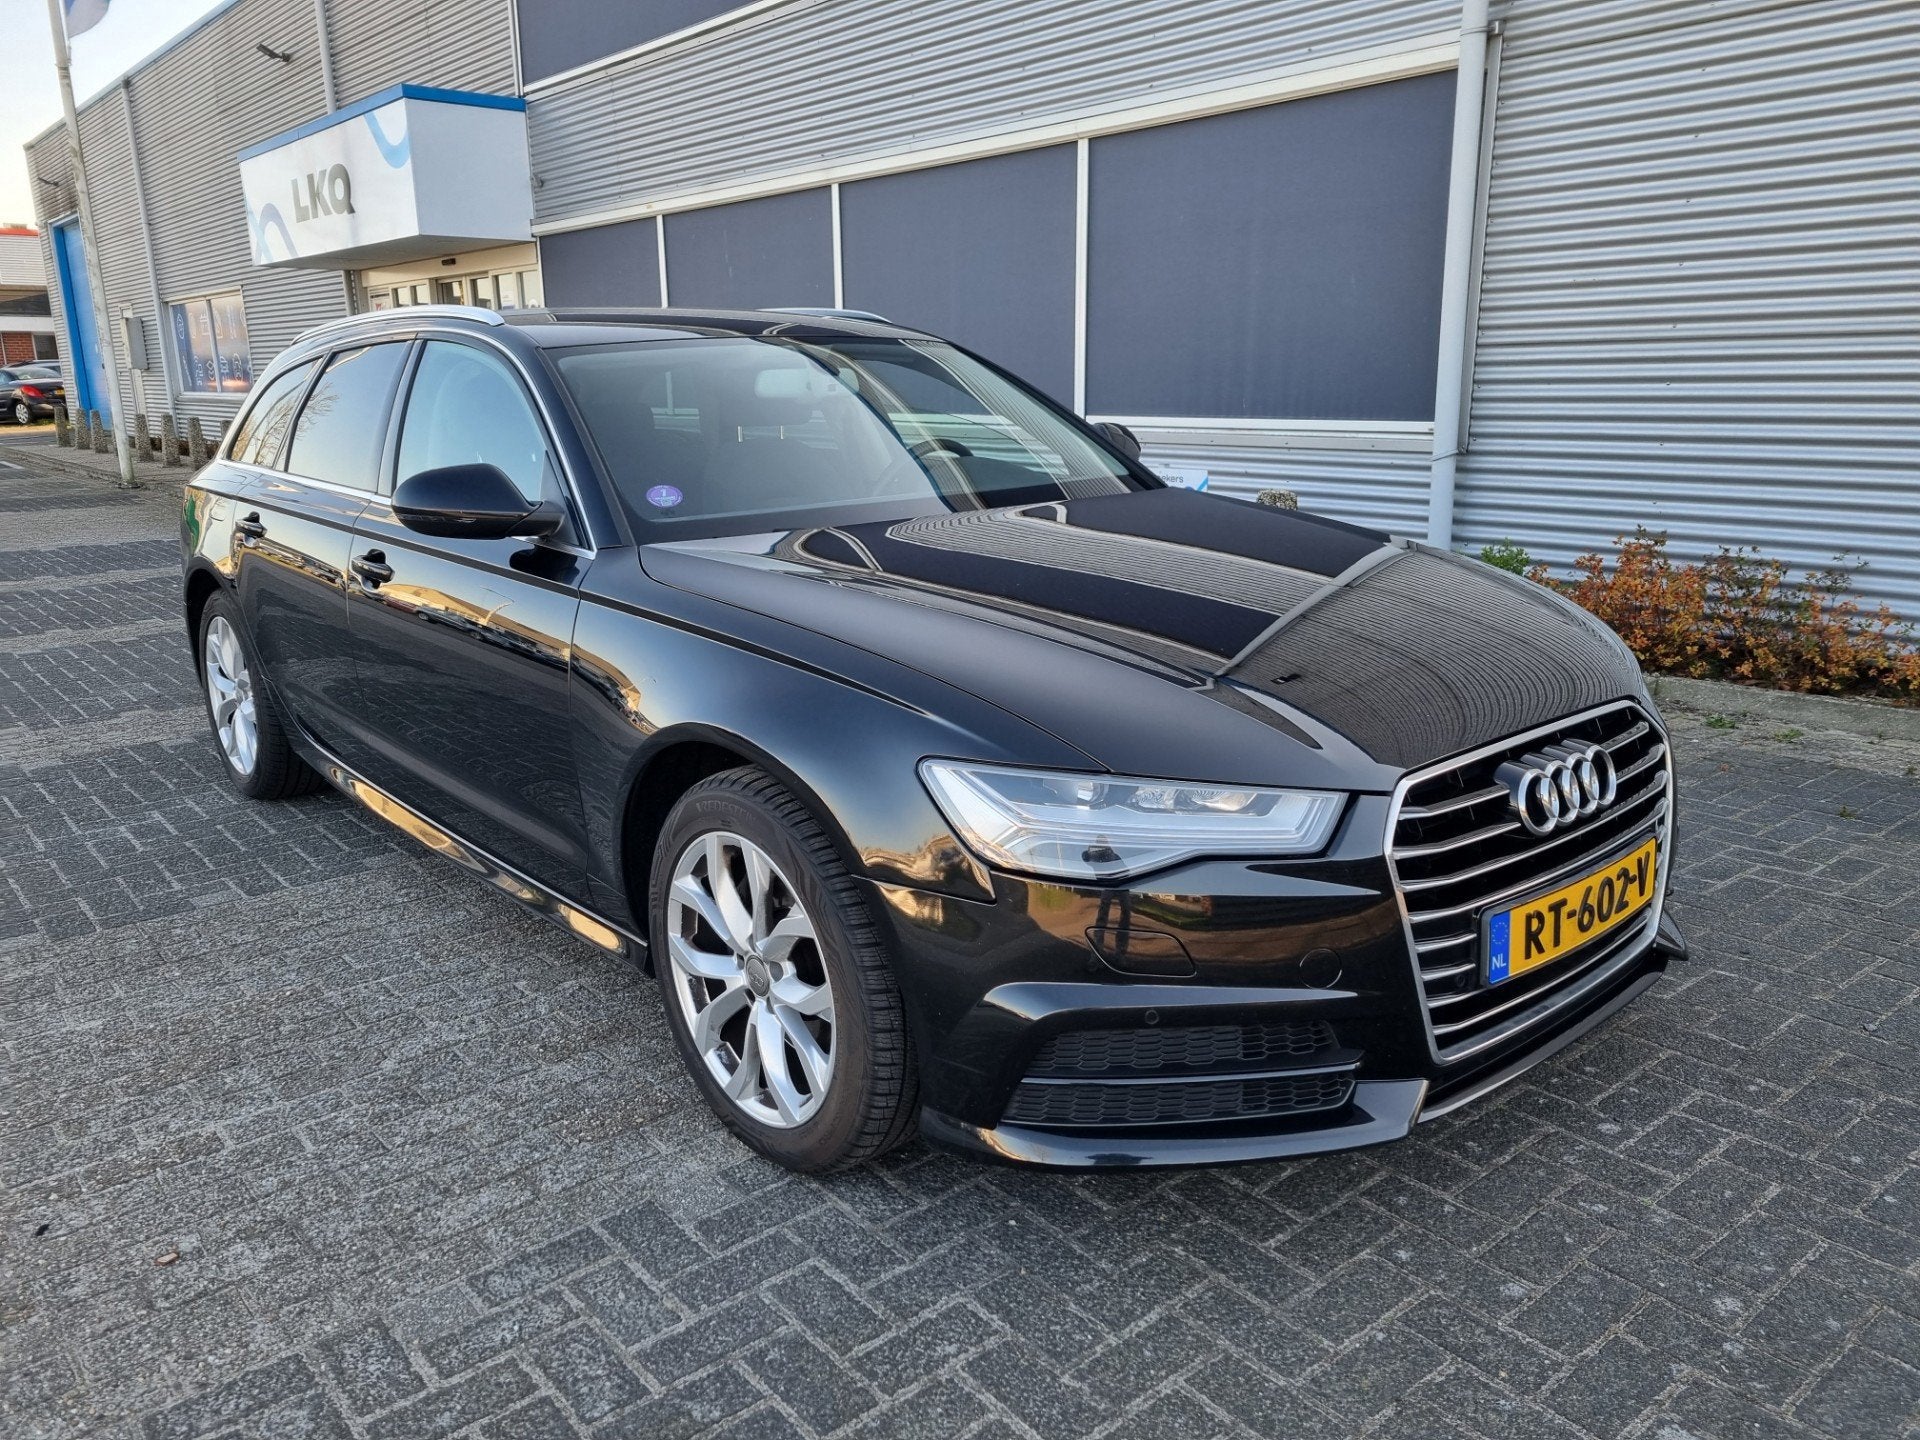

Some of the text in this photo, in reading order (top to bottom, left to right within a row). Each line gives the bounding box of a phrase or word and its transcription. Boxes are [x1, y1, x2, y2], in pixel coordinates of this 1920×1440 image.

[291, 163, 355, 223] LKQ
[1524, 851, 1650, 960] RT-602-V
[1492, 953, 1506, 970] NL
